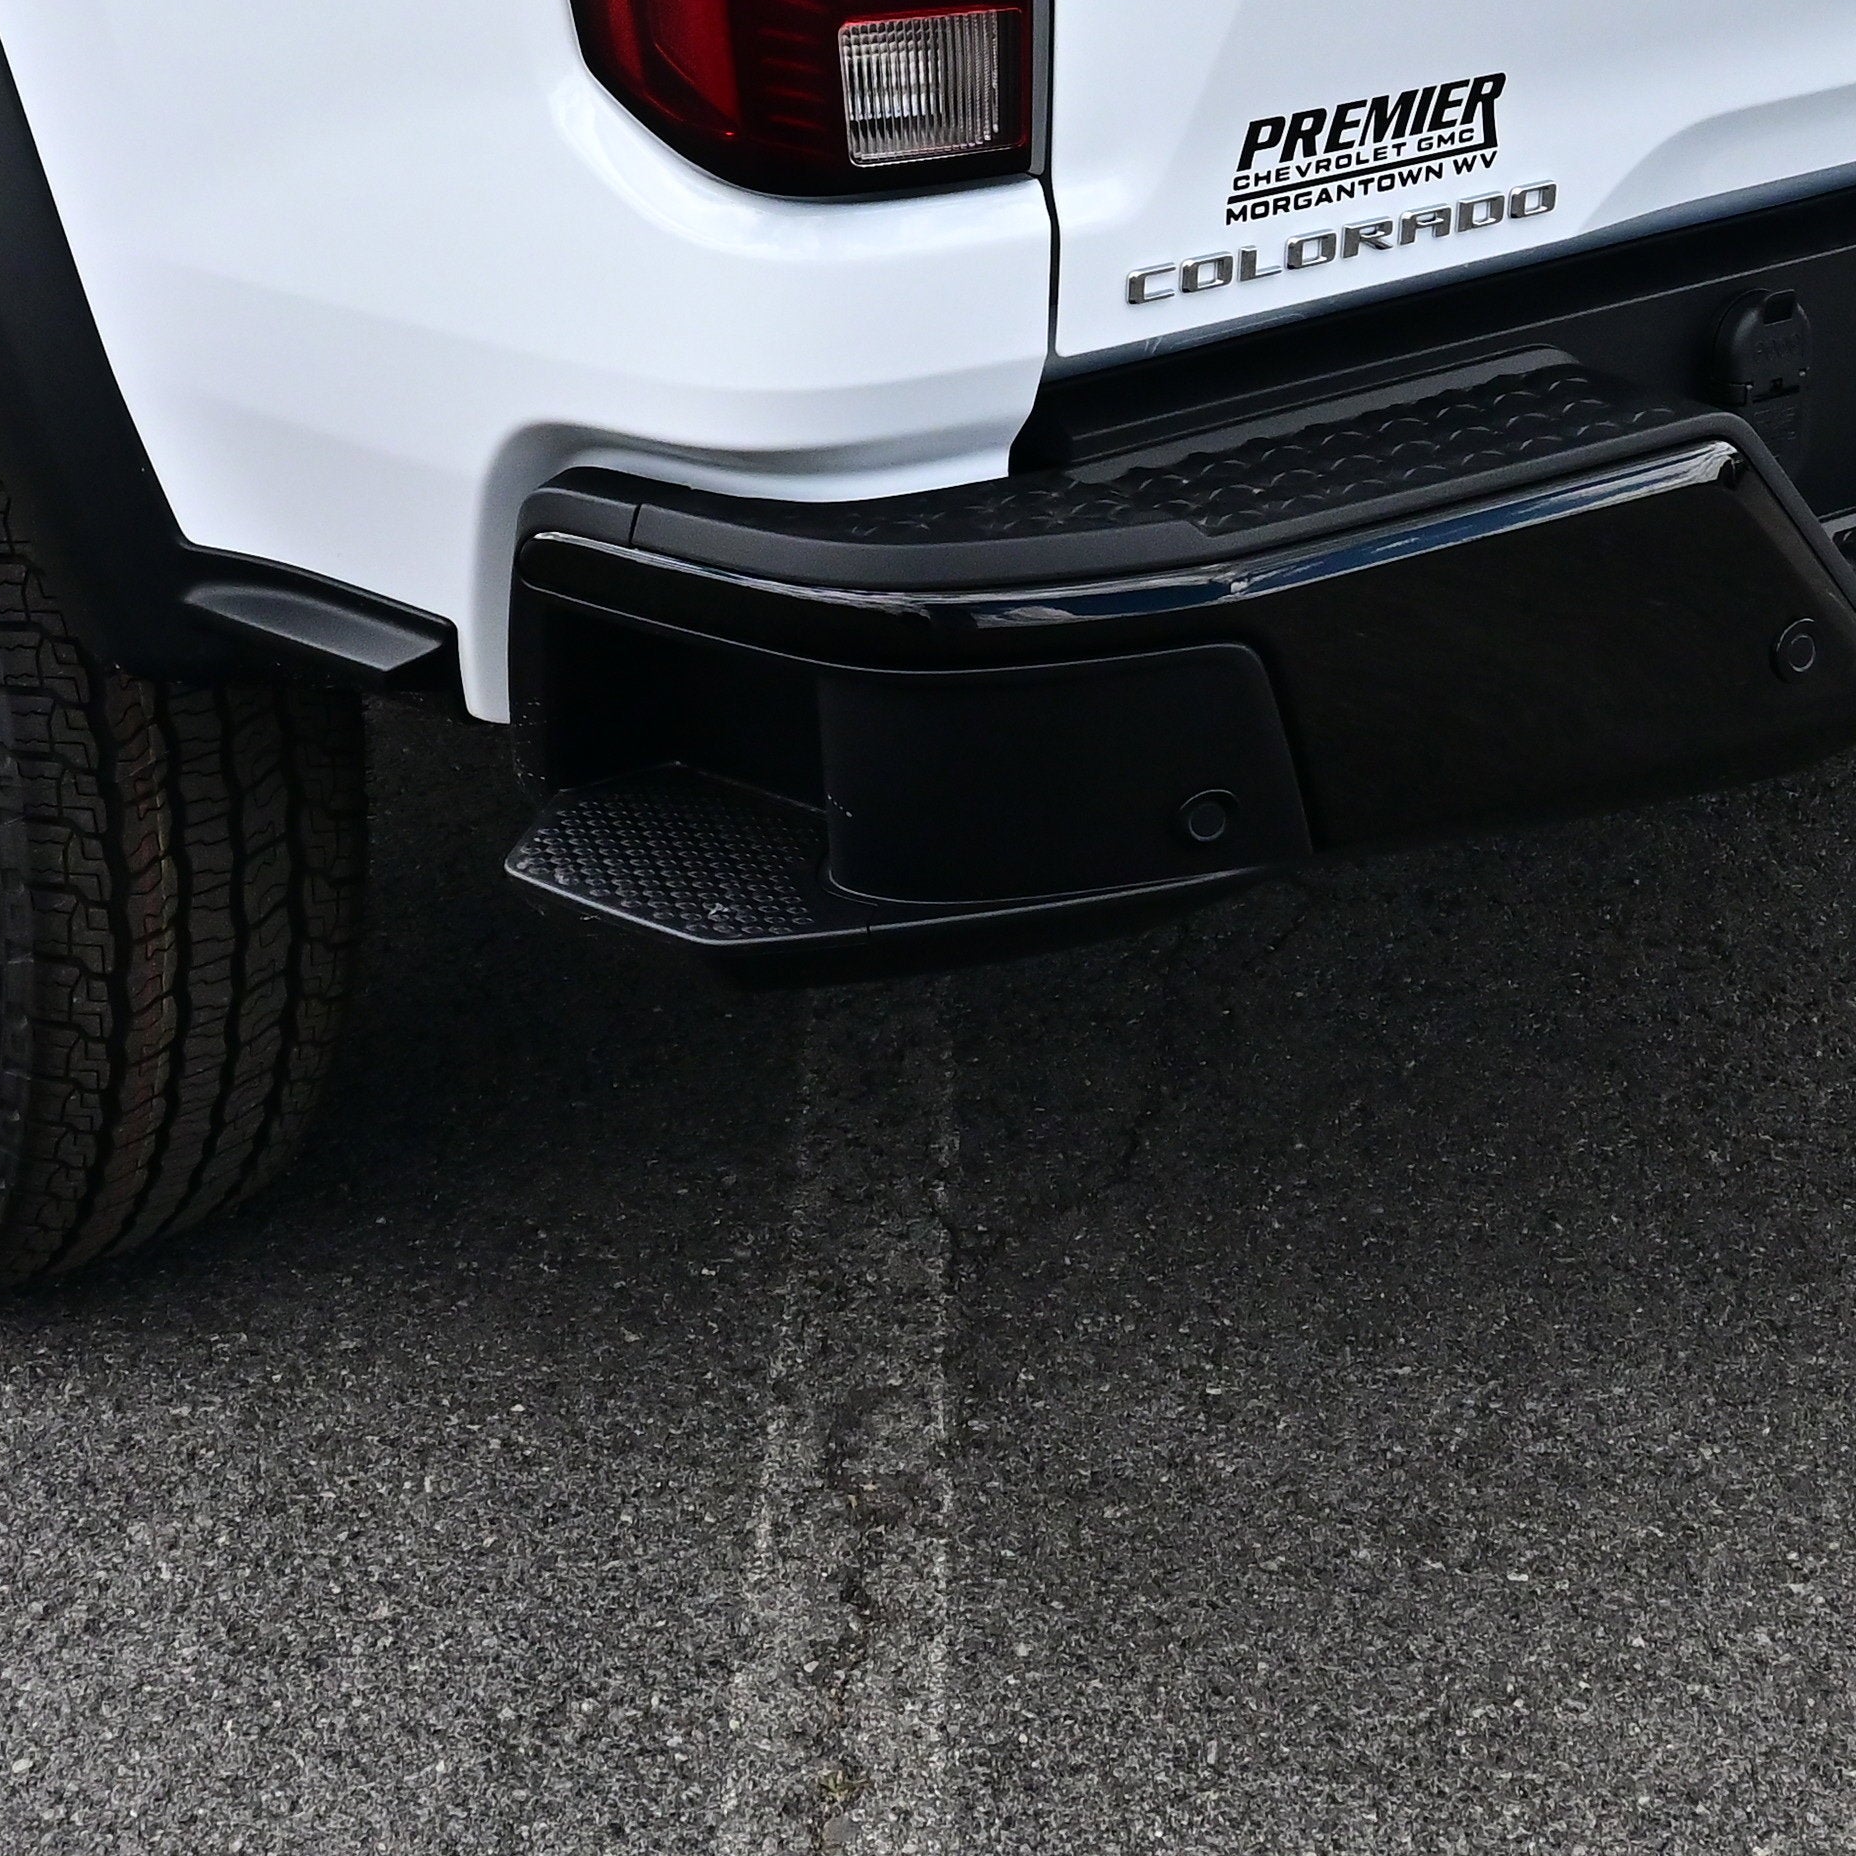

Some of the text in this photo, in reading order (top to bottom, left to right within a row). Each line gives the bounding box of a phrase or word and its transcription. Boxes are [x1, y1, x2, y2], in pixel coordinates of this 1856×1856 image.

[1232, 128, 1476, 192] CHEVROLET GMC
[1236, 72, 1507, 172] PREMIER
[1225, 149, 1499, 227] MORGANTOWN WV
[1126, 179, 1559, 305] COLORADO
